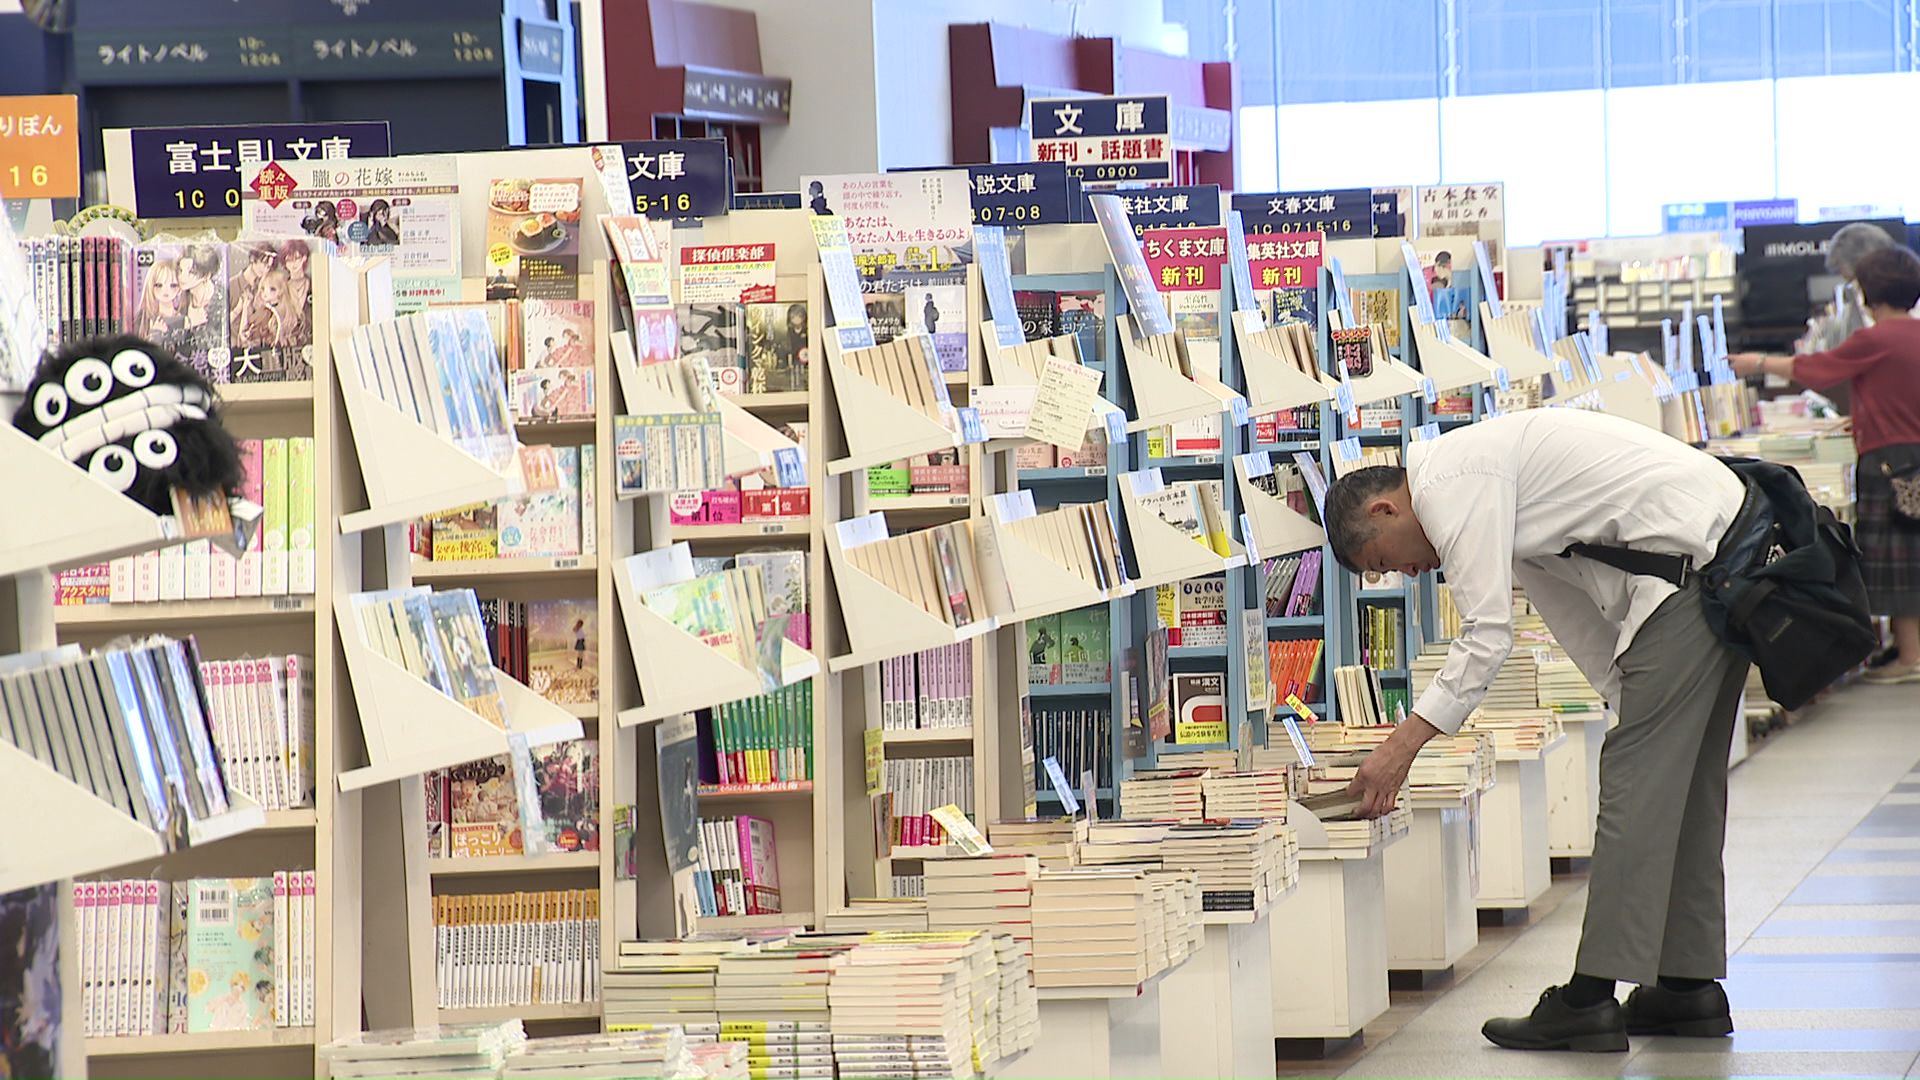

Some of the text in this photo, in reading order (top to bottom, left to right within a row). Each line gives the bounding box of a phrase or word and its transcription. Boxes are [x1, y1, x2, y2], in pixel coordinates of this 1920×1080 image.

[98, 43, 208, 64] ライトノベル
[313, 38, 418, 59] ライトノベル
[0, 114, 62, 137] りぼん
[1053, 101, 1145, 135] 文庫
[1037, 139, 1164, 162] 新刊・話題書
[628, 151, 686, 181] 文庫
[1096, 166, 1137, 178] 0900
[259, 170, 286, 184] 続々
[312, 167, 393, 188] 朧の花嫁
[259, 186, 289, 200] 重版
[635, 194, 692, 213] 5-16
[1267, 194, 1336, 215] 文春文庫
[844, 215, 894, 229] あなたは、
[692, 246, 765, 262] 探偵倶楽部
[1146, 237, 1226, 258] ちくま文庫
[1247, 239, 1320, 261] 集英社文庫
[1161, 265, 1204, 286] 新刊
[1261, 266, 1302, 286] 新刊
[1023, 320, 1054, 335] の家
[453, 831, 501, 847] ほっこり
